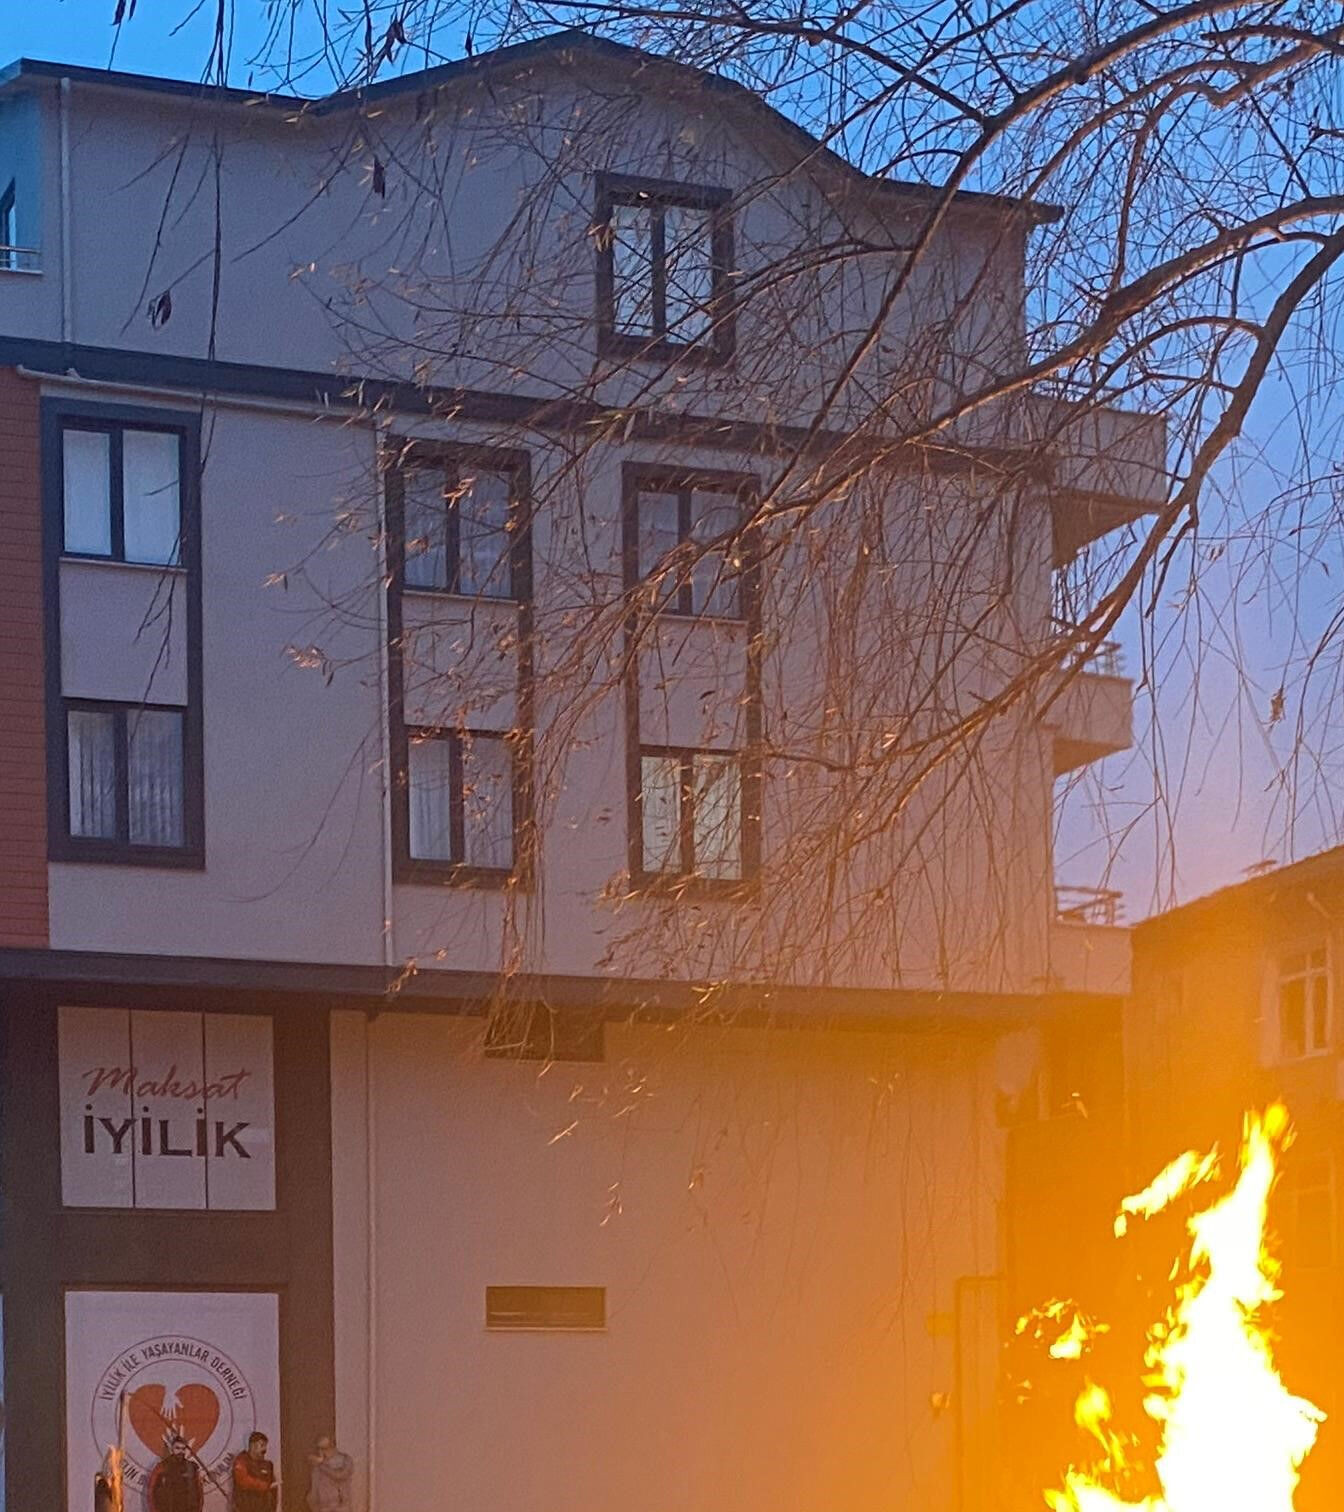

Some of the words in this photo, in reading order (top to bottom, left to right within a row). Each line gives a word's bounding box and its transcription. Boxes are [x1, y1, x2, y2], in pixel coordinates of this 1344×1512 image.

[82, 1065, 252, 1100] Maksat
[84, 1103, 251, 1158] İYİLİK
[100, 1367, 126, 1401] İYİLİK
[122, 1354, 140, 1373] İLE
[141, 1343, 210, 1363] YAŞAYANLAR
[211, 1357, 247, 1401] DERNEĞİ
